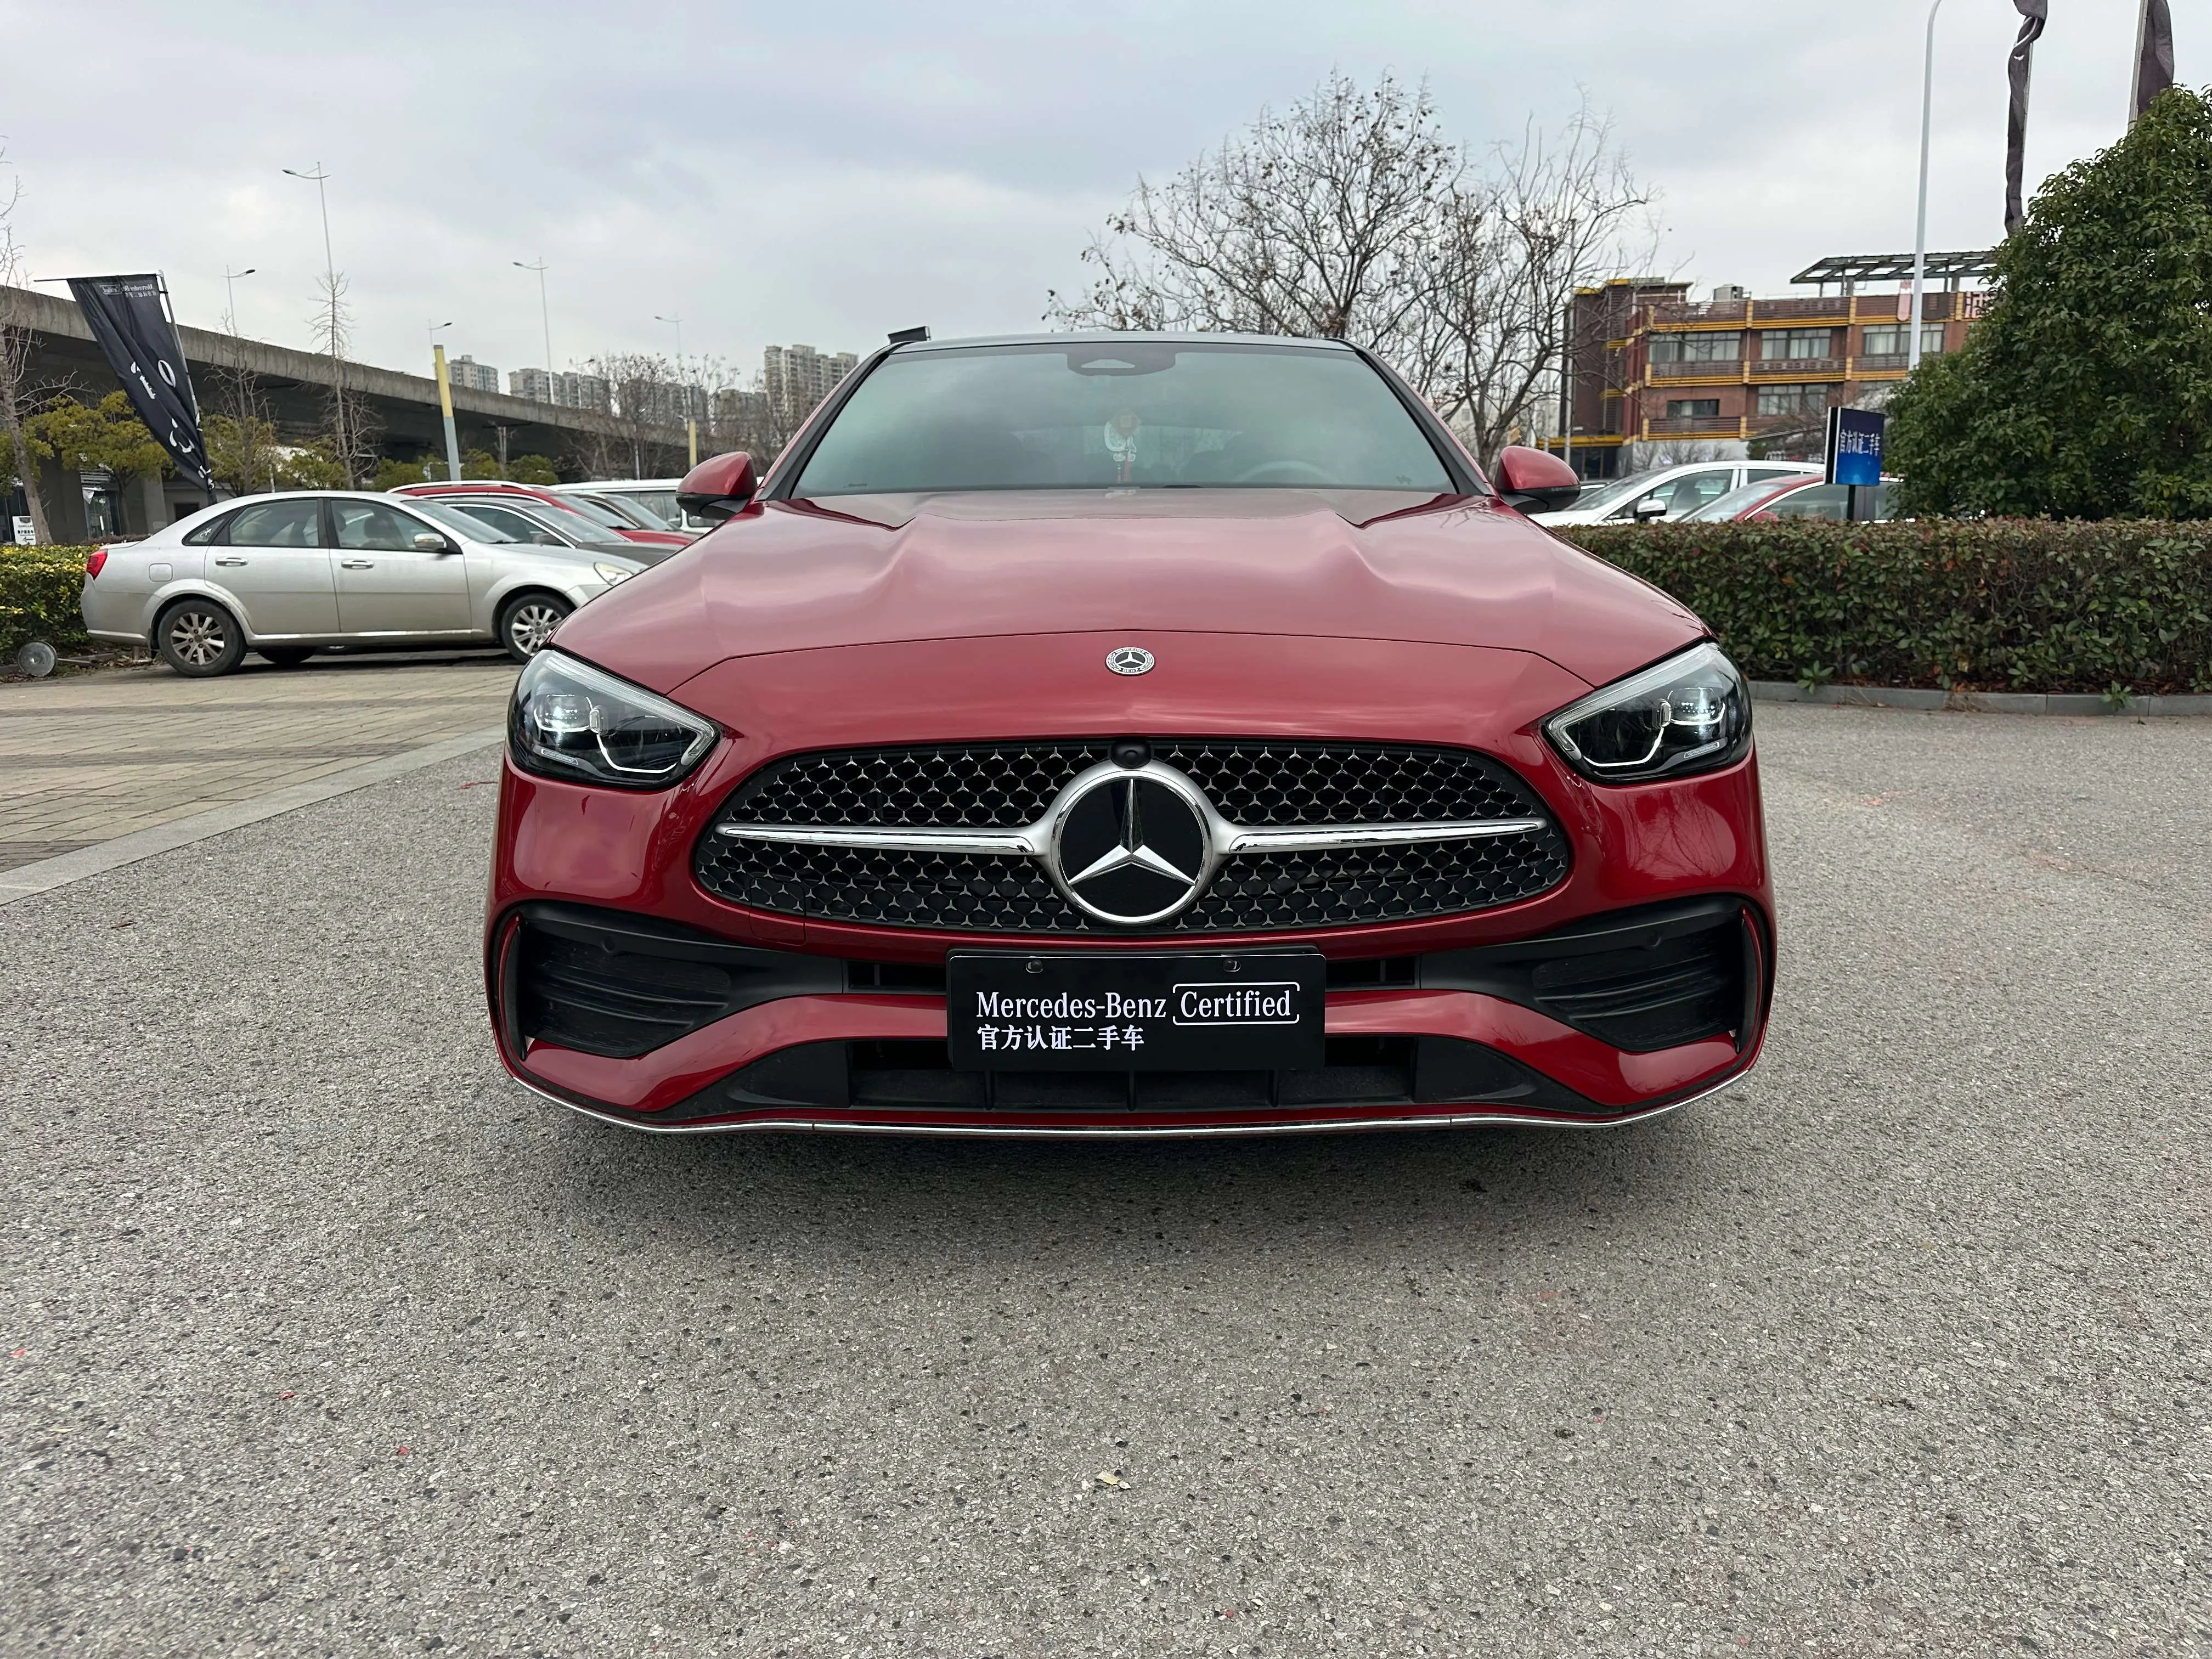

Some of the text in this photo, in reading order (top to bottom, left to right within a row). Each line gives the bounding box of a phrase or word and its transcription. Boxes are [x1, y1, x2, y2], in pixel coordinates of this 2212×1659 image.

[1840, 428, 1881, 456] 官方认证二手车
[976, 990, 1291, 1018] Mercedes-Benz Certified
[977, 1024, 1144, 1051] 官方认证二手车
